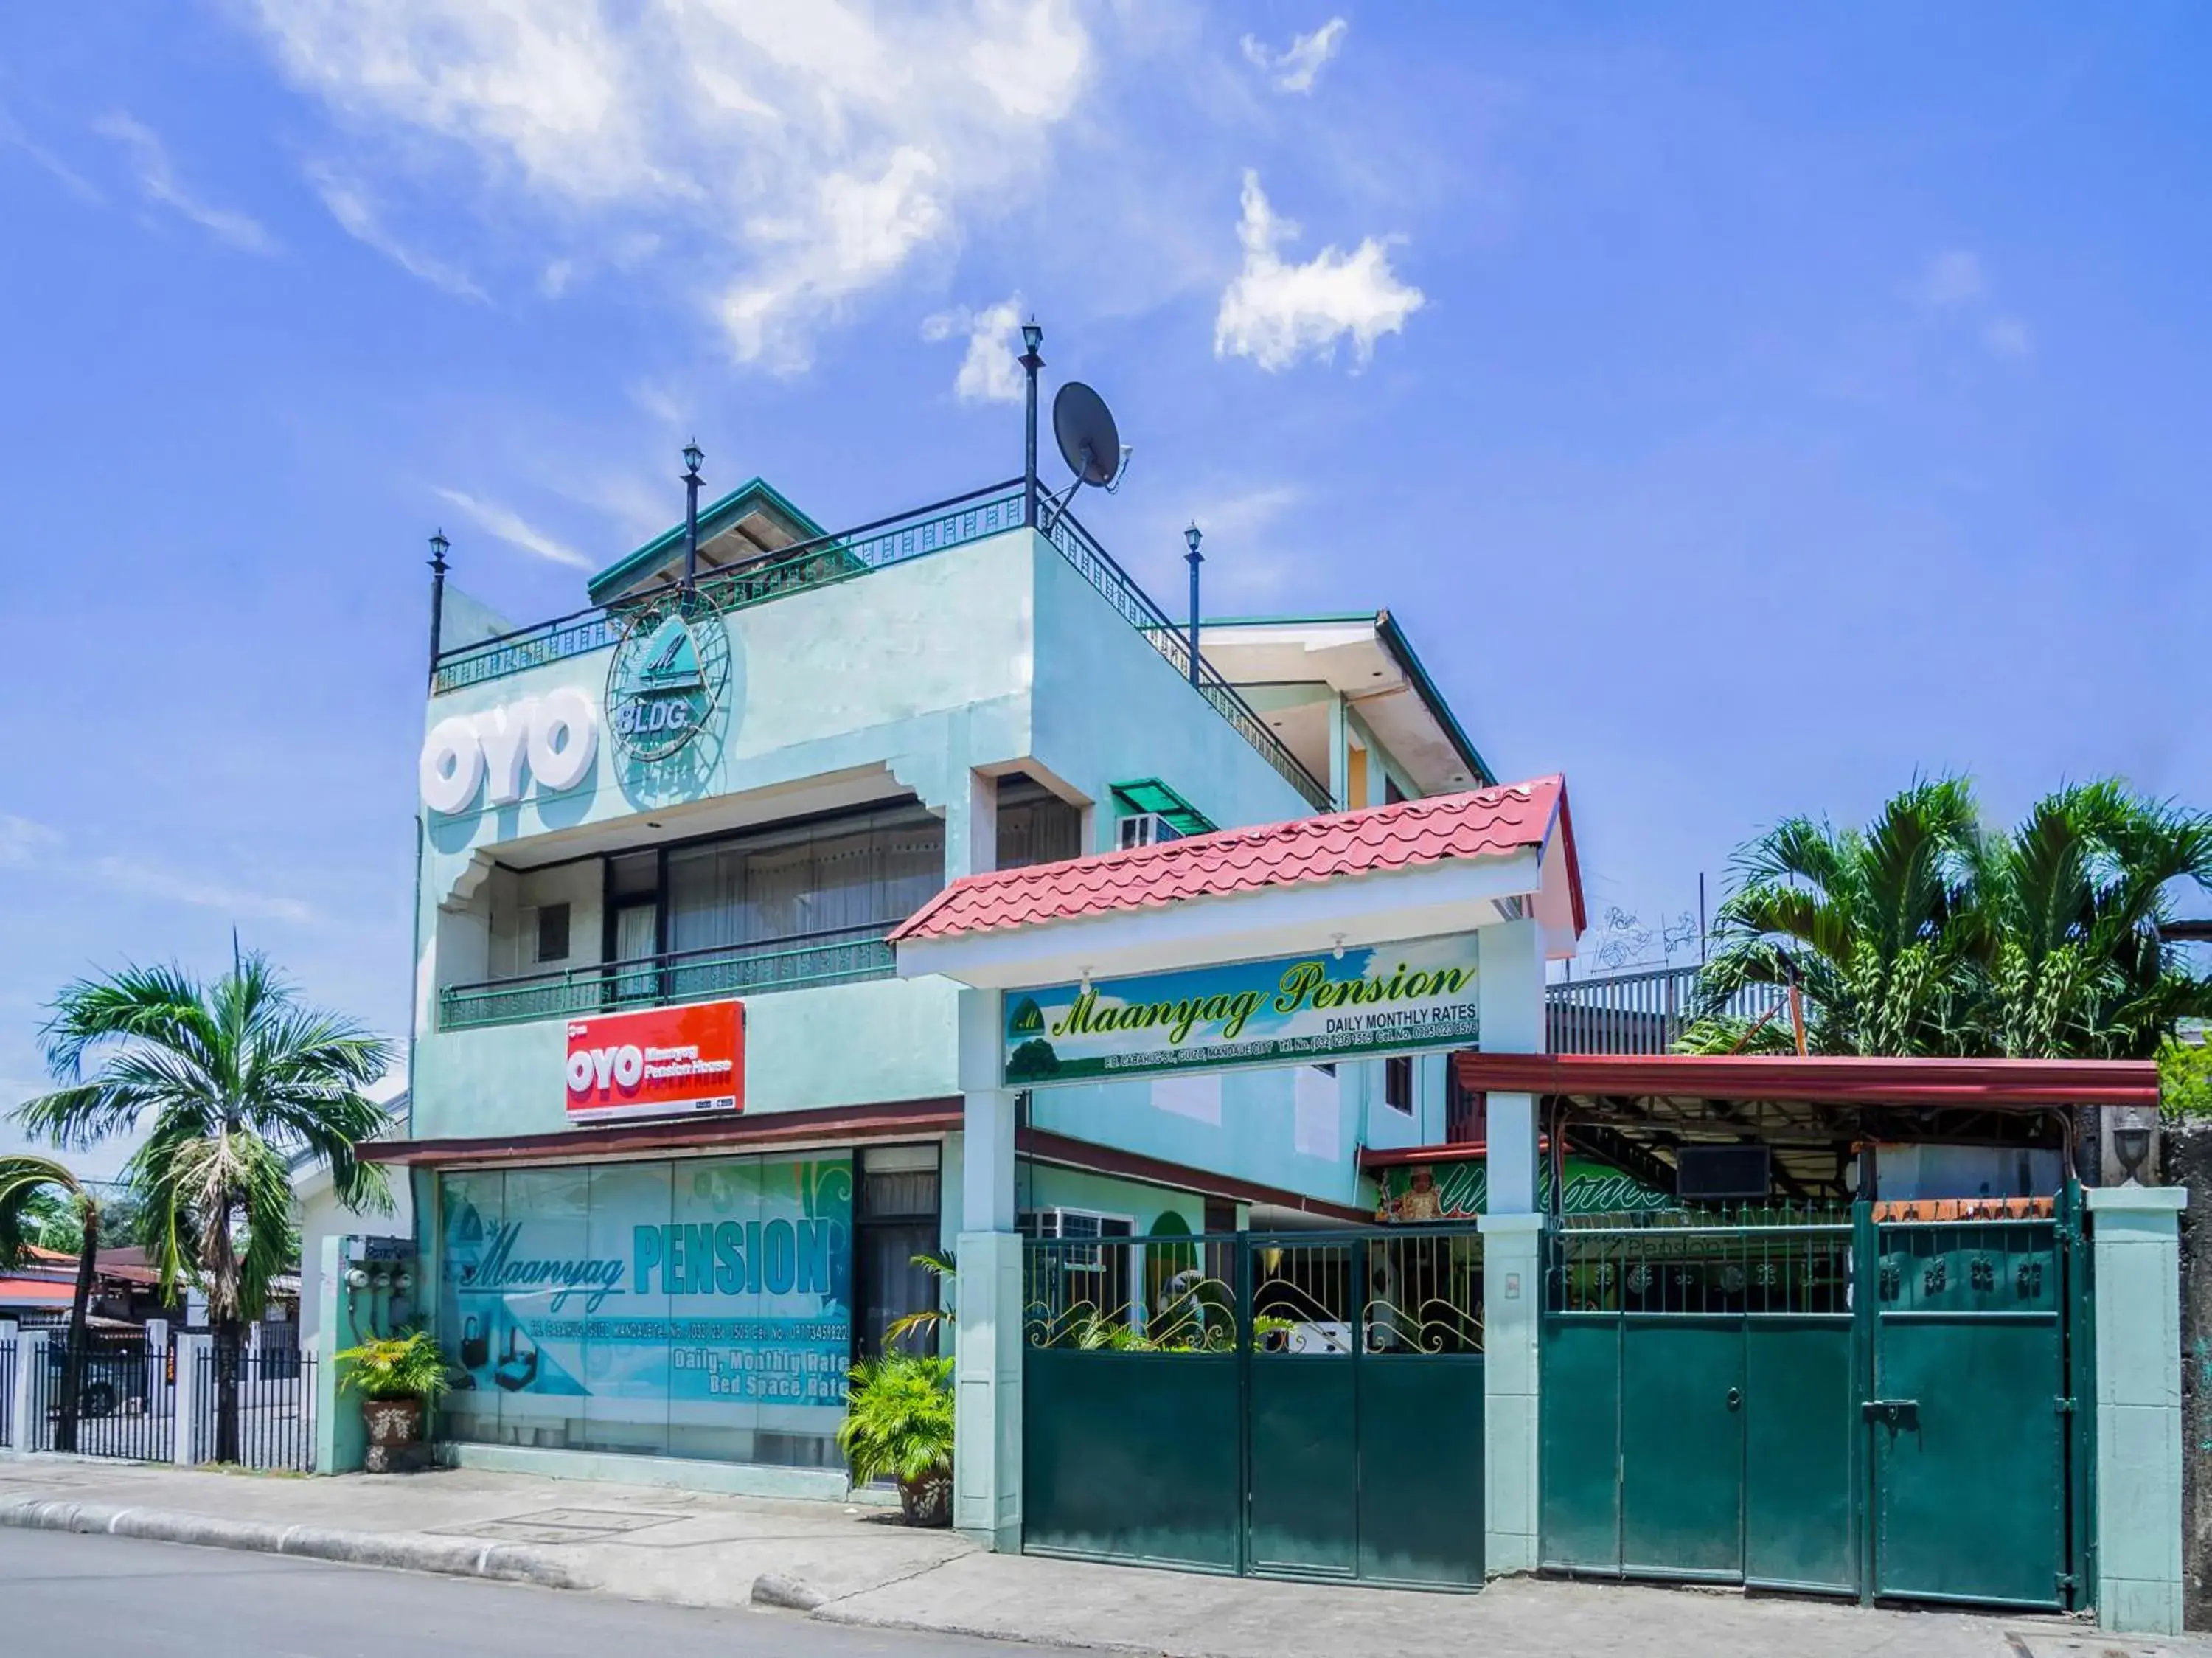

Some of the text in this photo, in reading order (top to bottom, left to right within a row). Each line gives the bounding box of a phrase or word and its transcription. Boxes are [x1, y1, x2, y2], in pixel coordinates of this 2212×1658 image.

[616, 700, 689, 735] BLDG.
[420, 687, 599, 816] OYO
[1052, 961, 1475, 1044] Maanyag Pension
[1326, 1003, 1475, 1033] DAILY MONTHLY RATES
[567, 1044, 643, 1092] OYO
[644, 1059, 732, 1079] Pension House
[460, 1218, 830, 1313] Maanyag PENSION
[674, 1349, 723, 1374] Daily,
[730, 1350, 801, 1376] Monthly
[709, 1374, 741, 1395] Bed
[746, 1375, 801, 1400] Space
